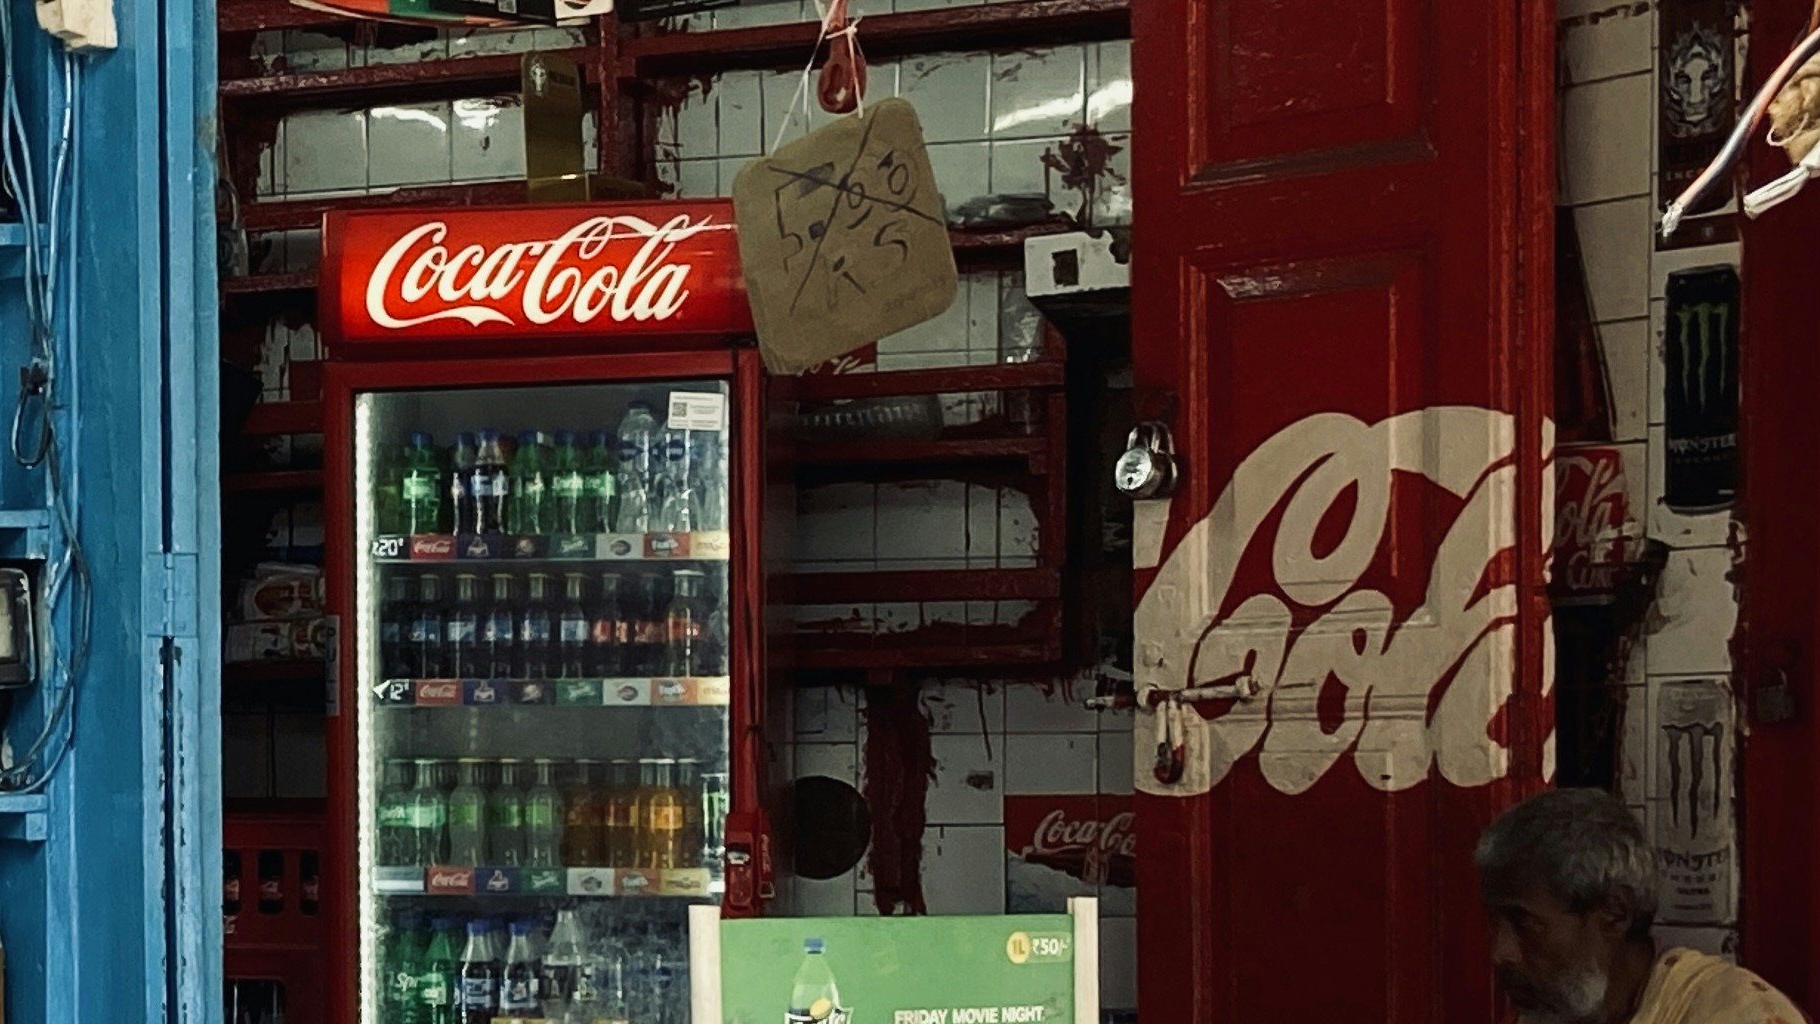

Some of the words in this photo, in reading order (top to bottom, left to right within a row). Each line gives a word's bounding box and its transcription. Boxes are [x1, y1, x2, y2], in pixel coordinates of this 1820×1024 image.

[364, 213, 725, 331] Coca-Cola
[1033, 809, 1136, 858] Coca-Co
[952, 1007, 998, 1024] MOVIE
